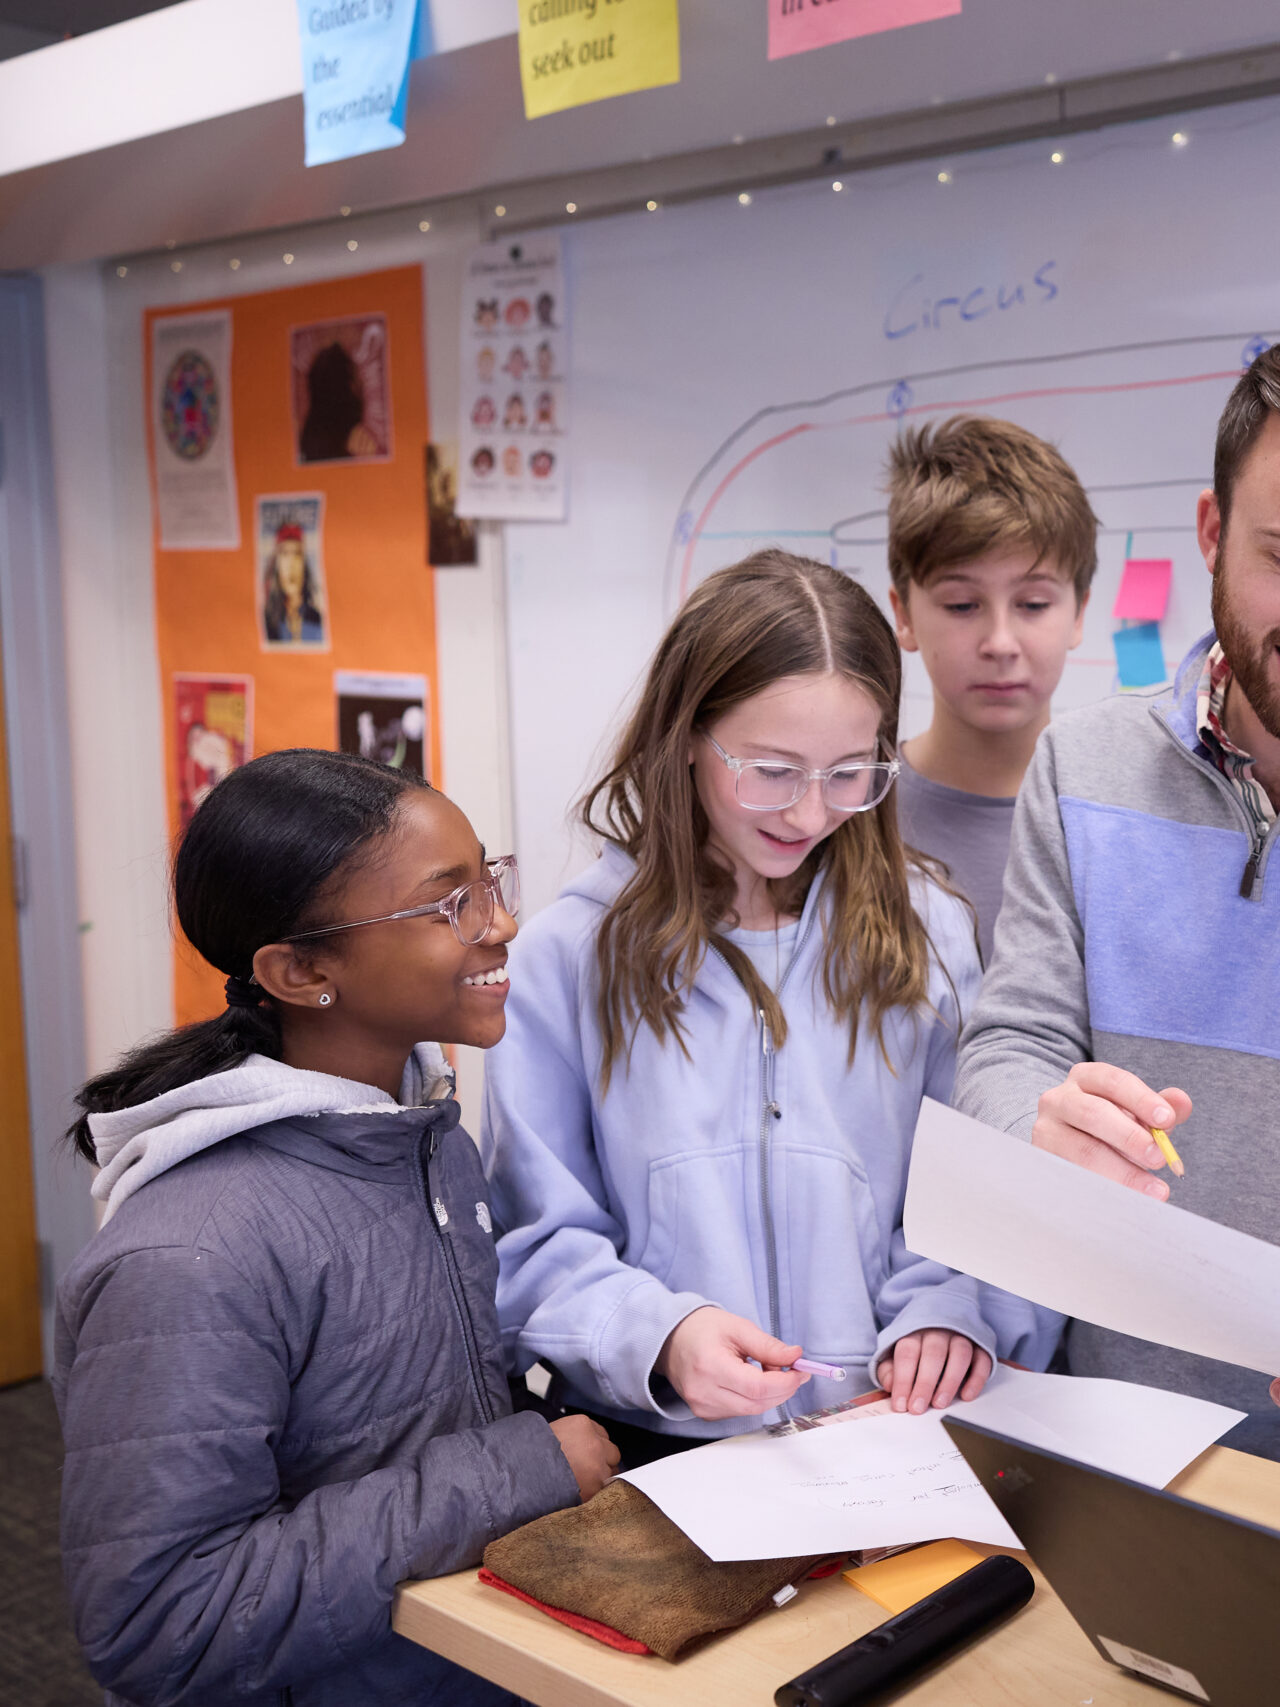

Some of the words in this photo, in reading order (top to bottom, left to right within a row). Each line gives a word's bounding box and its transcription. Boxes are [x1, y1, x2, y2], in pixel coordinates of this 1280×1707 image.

[531, 39, 574, 80] seek
[578, 32, 616, 65] out
[883, 260, 1059, 341] Circus
